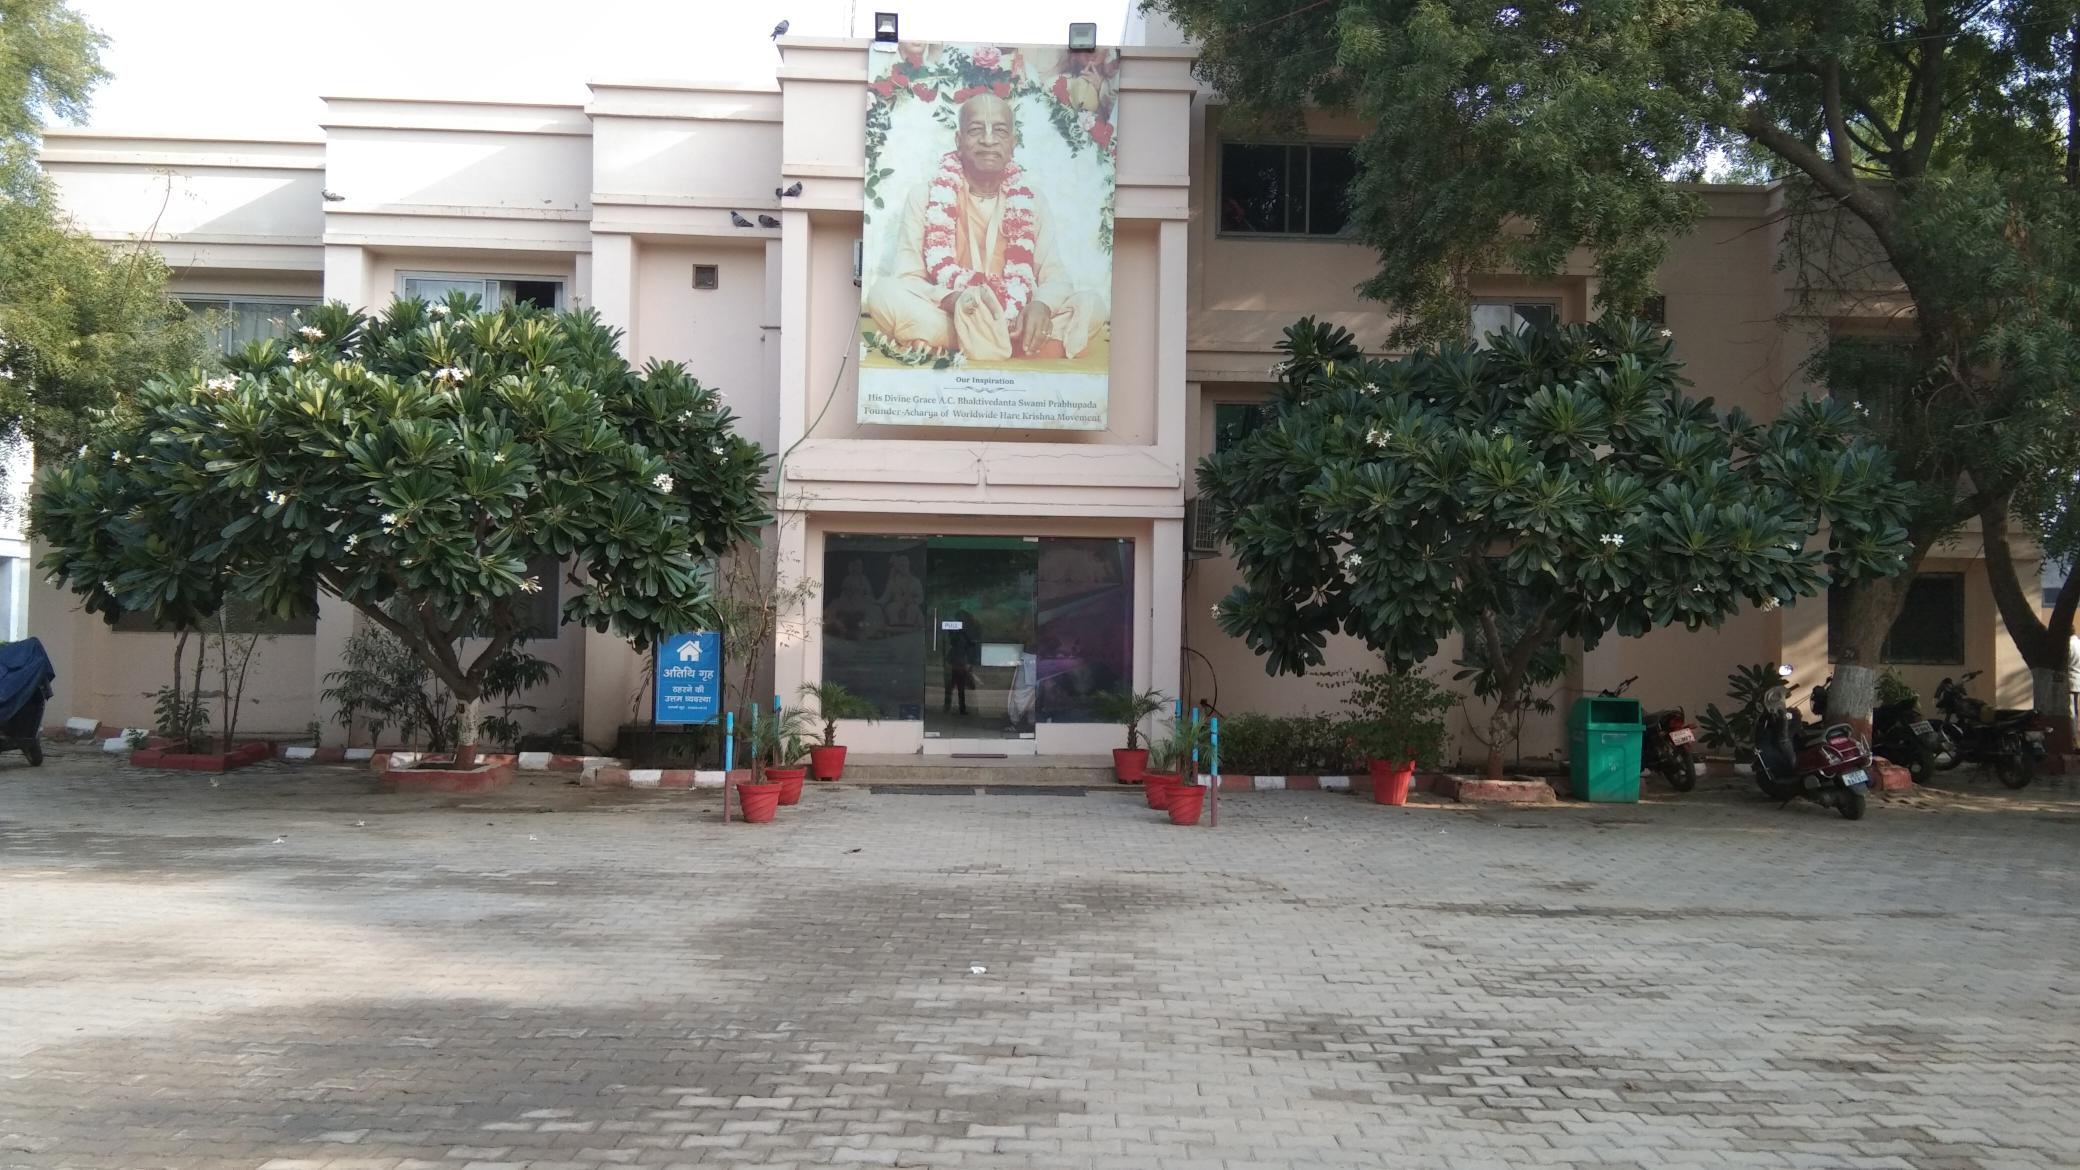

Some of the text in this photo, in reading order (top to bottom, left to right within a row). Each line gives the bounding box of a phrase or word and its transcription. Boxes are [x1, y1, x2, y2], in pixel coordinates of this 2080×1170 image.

[972, 376, 1015, 386] Inspiration
[868, 393, 1097, 410] His Divine Grace A.C. Bhaktivedanta Swami Prabhupada
[864, 406, 1101, 423] Founder-Acharya of Worldwide Hare Krishna Movement
[663, 666, 714, 681] अतिथि गृह
[672, 684, 704, 693] ठहरने की
[664, 695, 711, 703] उत्तम व्यवस्था
